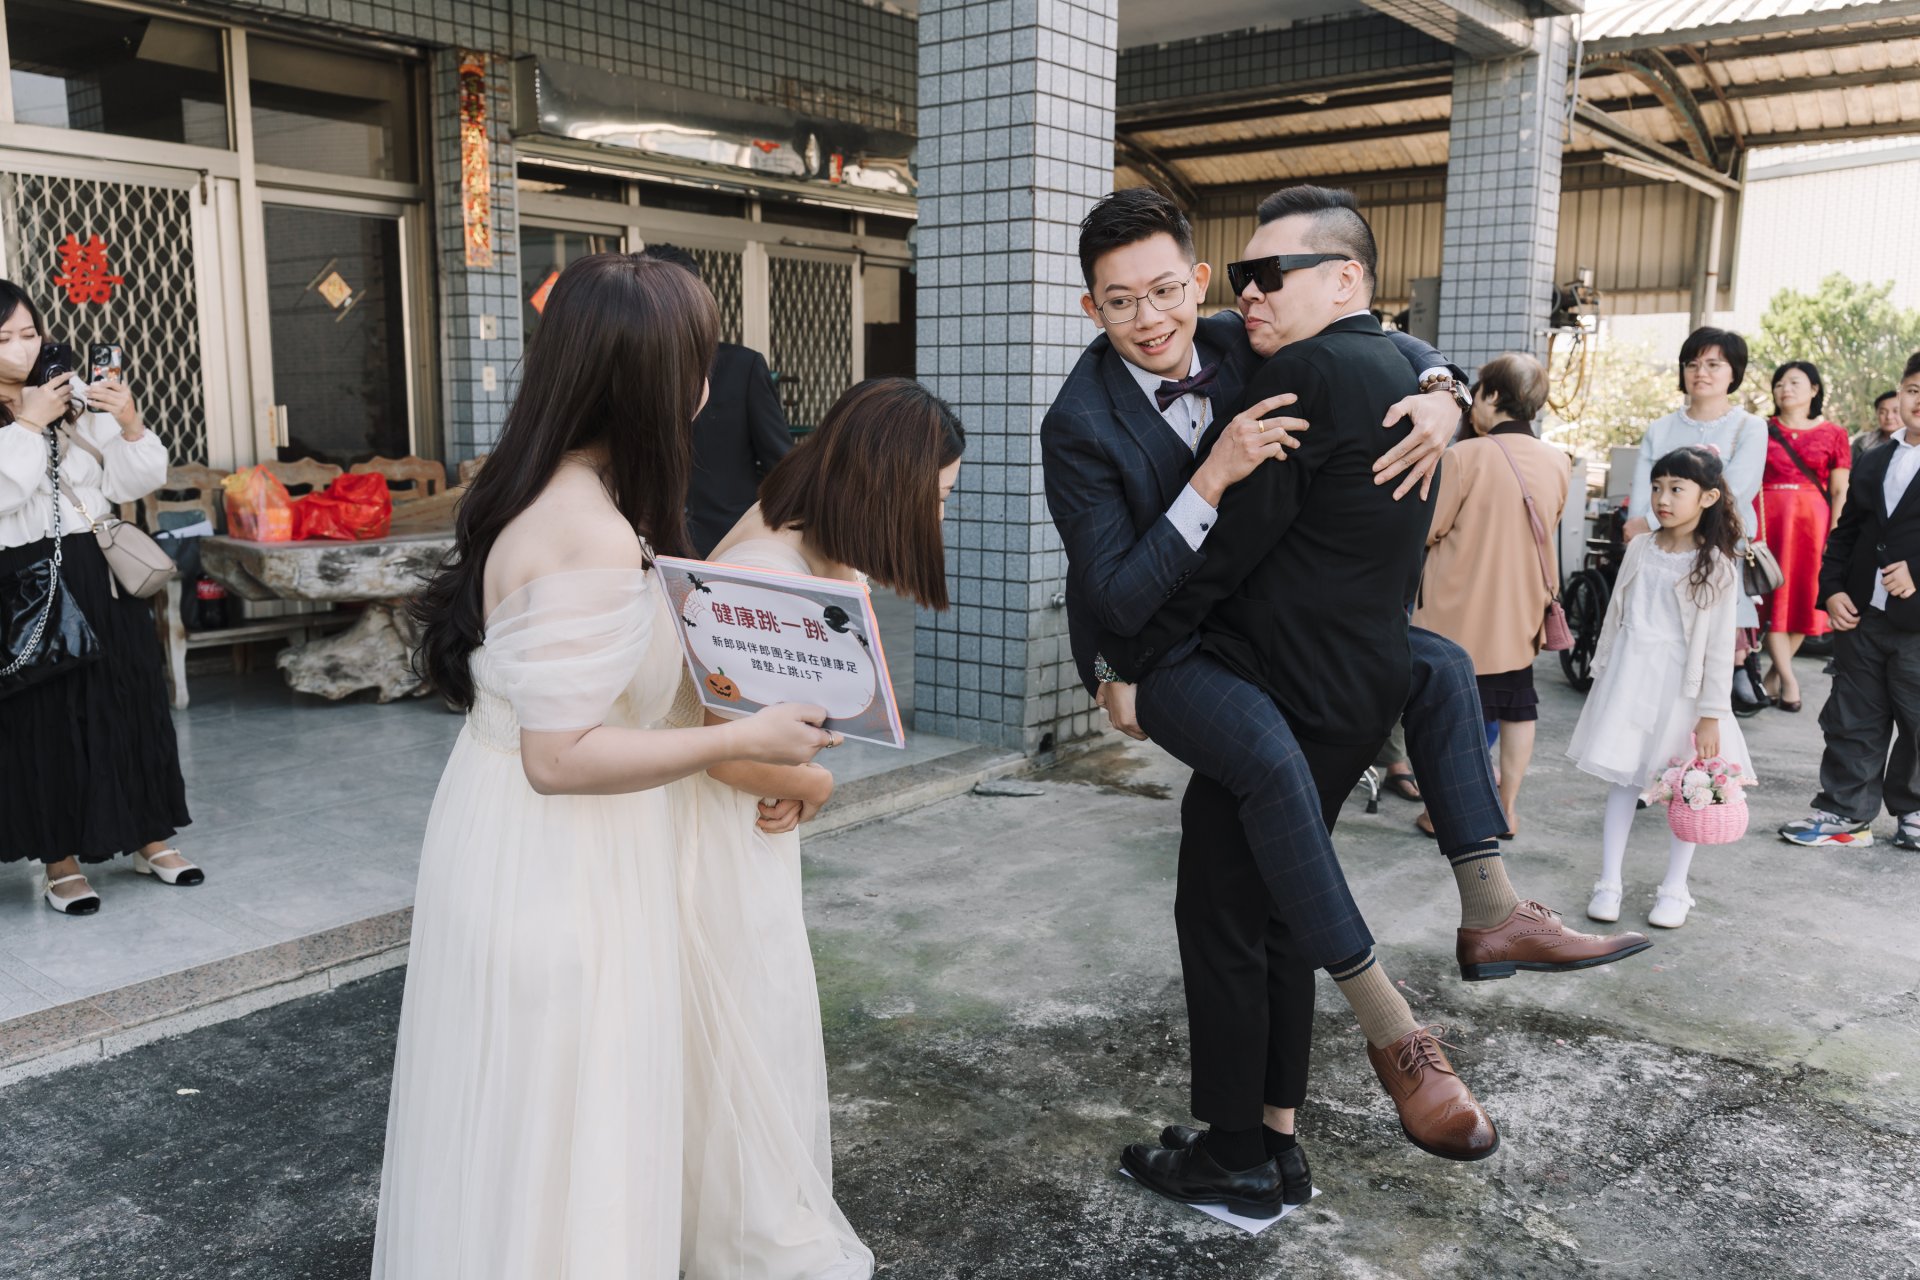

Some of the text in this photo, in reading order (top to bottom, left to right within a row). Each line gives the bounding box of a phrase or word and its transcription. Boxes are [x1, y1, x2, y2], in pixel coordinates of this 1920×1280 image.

[712, 601, 829, 642] 健康跳一跳
[712, 635, 858, 674] 新郎與伴郎團全員在健康足
[751, 658, 823, 682] 踏墊上跳15下
